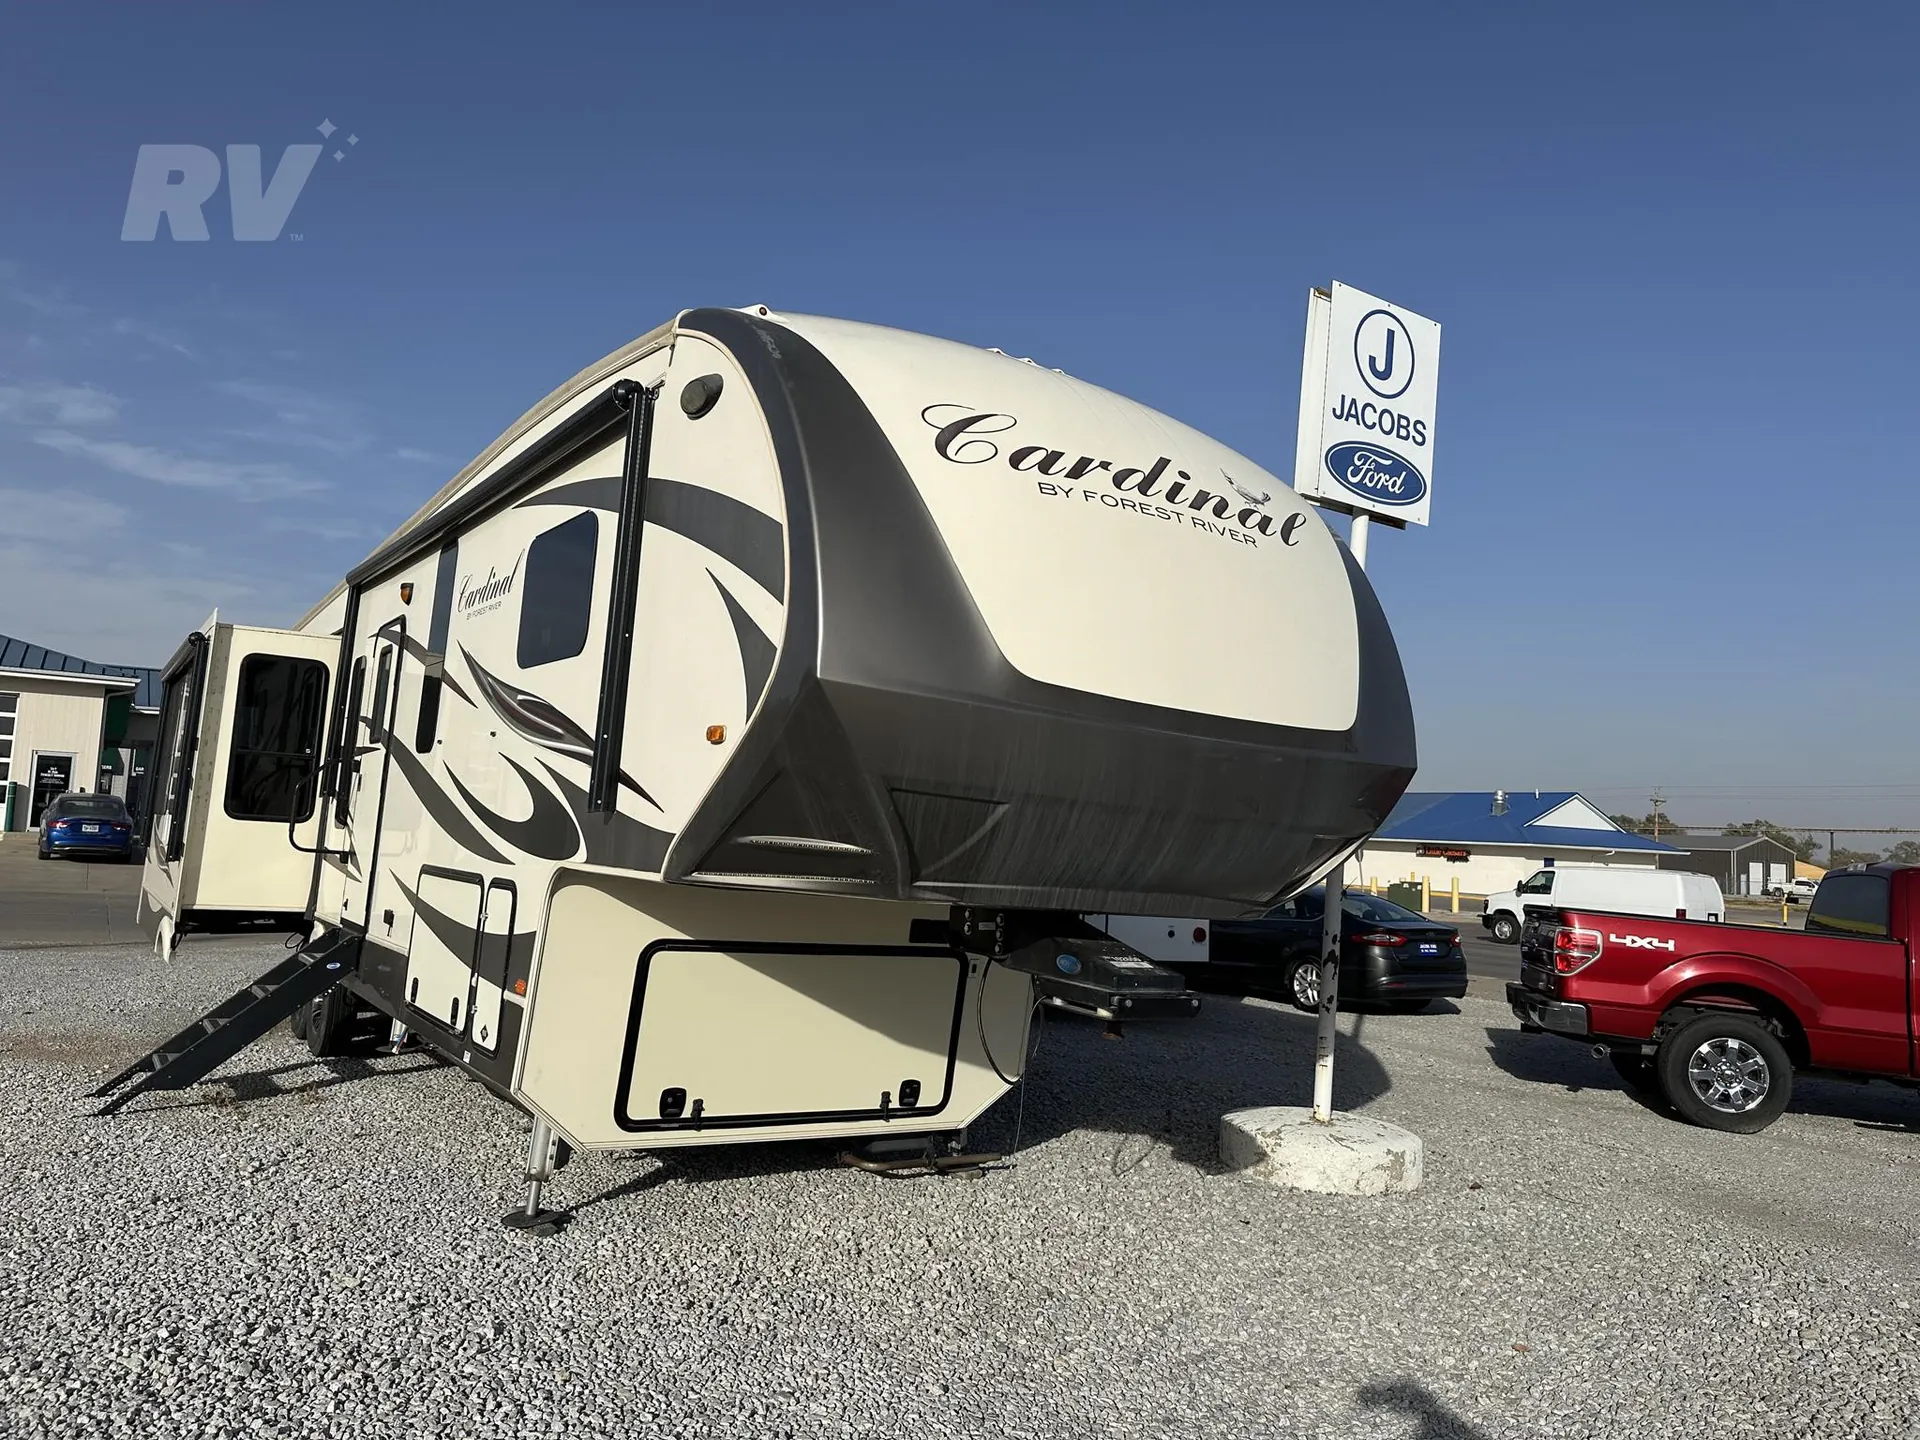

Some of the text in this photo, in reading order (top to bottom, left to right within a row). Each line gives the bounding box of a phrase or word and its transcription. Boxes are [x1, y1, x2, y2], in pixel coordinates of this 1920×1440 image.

[1368, 327, 1396, 381] J
[1332, 394, 1427, 446] JACOBS
[920, 403, 1307, 547] Cardinal
[1346, 451, 1408, 494] Ford
[1037, 480, 1259, 549] BY FOREST RIVER
[458, 548, 526, 613] Cardinal
[1609, 933, 1675, 951] 4X4
